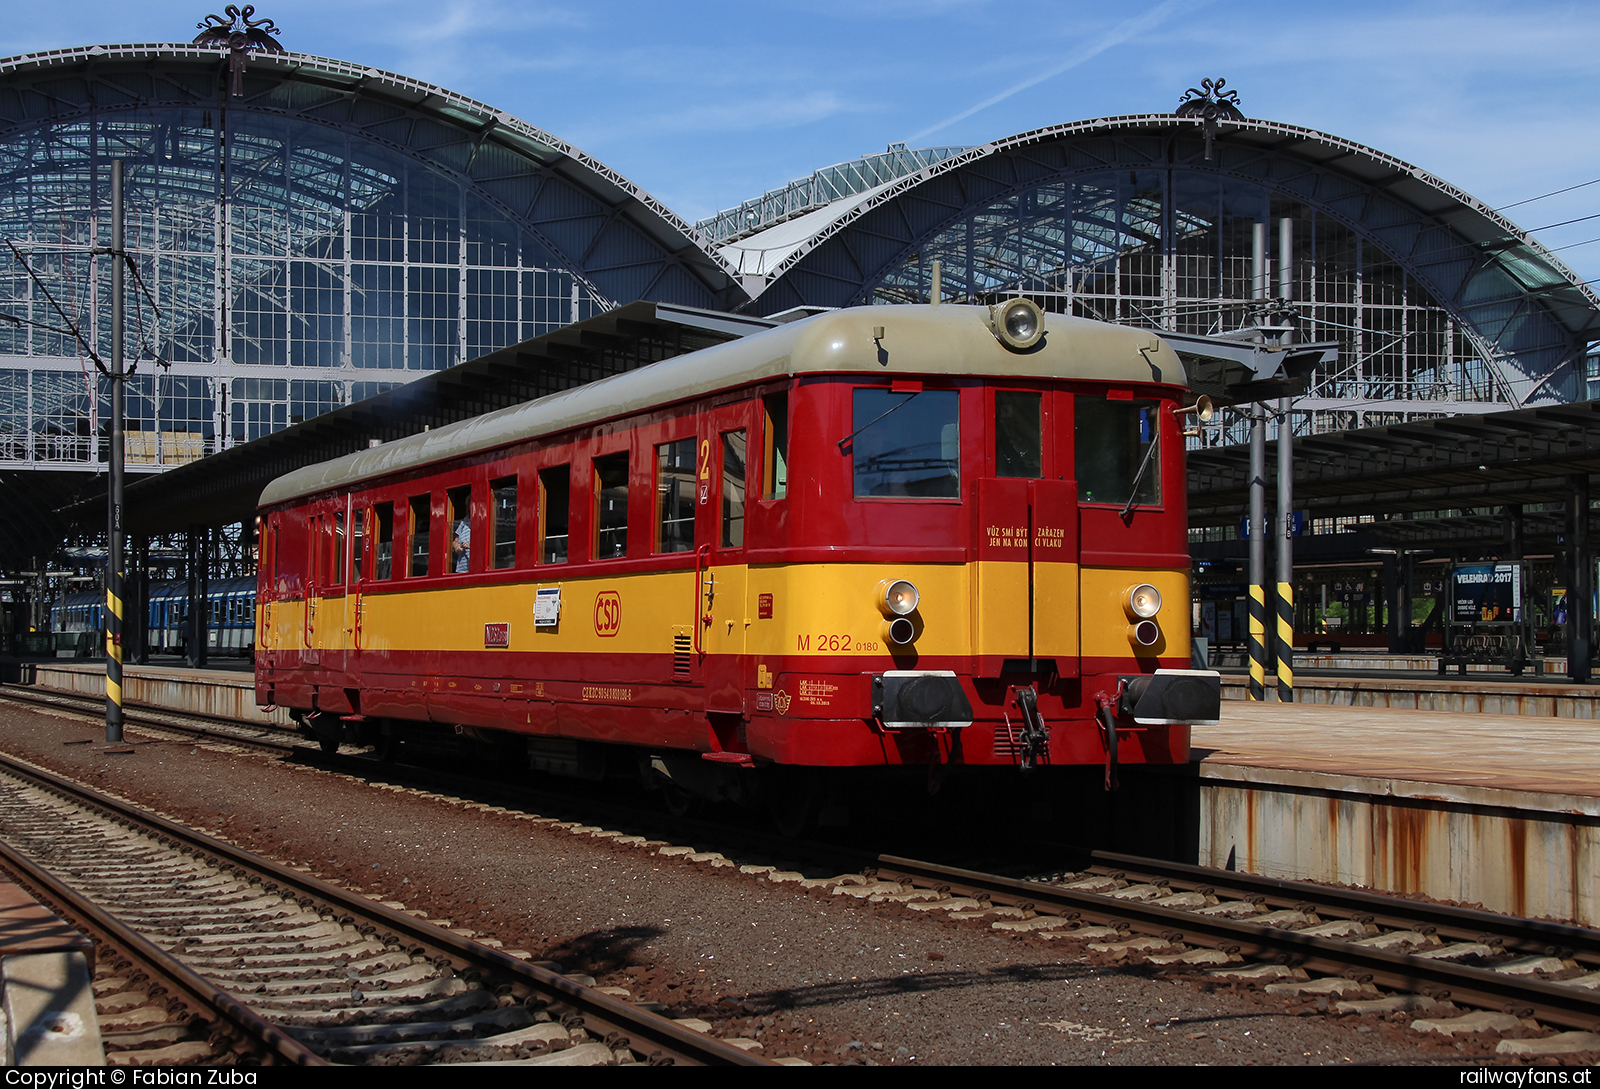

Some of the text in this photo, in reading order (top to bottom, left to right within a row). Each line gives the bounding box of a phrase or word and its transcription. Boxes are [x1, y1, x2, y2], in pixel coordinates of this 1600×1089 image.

[700, 439, 710, 480] 2
[366, 507, 371, 535] 2
[986, 525, 1065, 538] VŮZ SMÍ BÝT ZAŘAZEN
[989, 538, 1001, 547] JEN
[1003, 538, 1012, 547] NA
[1042, 538, 1062, 548] VLAKU
[1494, 572, 1512, 583] 2017
[596, 597, 620, 631] ČSD
[797, 634, 879, 652] M 262 0180
